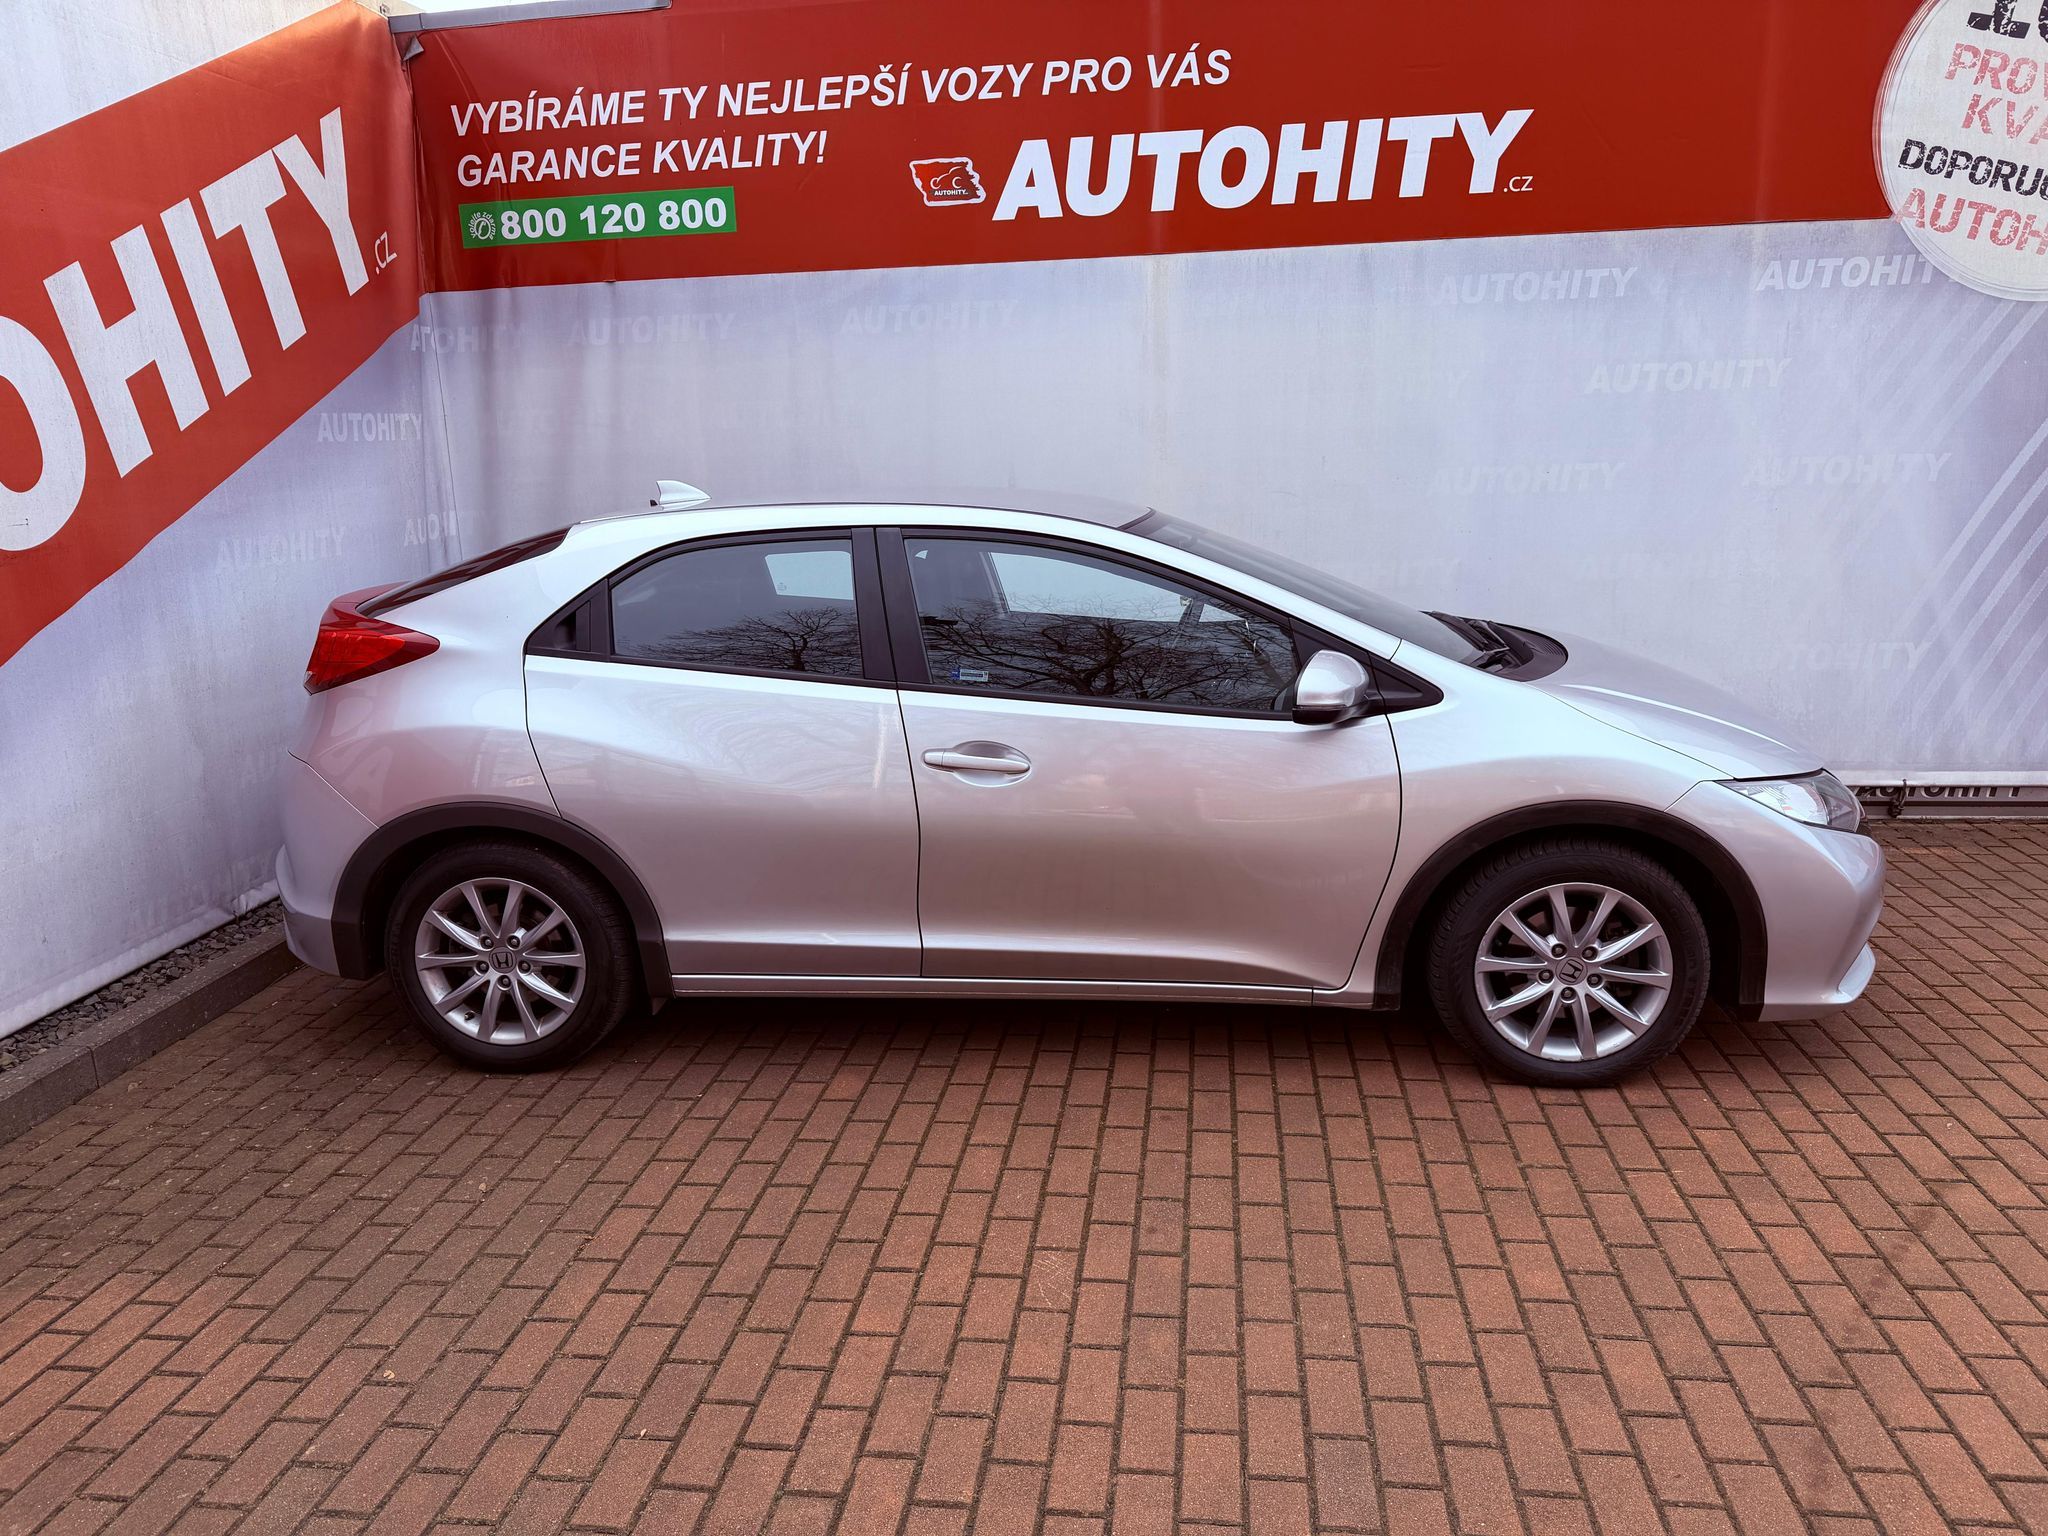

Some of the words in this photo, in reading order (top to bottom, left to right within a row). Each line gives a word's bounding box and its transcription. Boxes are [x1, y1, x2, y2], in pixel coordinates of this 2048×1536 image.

[451, 86, 645, 137] VYBÍRÁME
[659, 85, 708, 121] TY
[717, 62, 913, 118] NEJLEPŠÍ
[921, 62, 1034, 103] VOZY
[1041, 56, 1133, 96] PRO
[1146, 42, 1233, 89] VÁS
[457, 142, 642, 187] GARANCE
[652, 130, 828, 174] KVALITY!
[500, 207, 567, 240] 800
[579, 202, 646, 235] 120
[658, 197, 727, 231] 800
[1432, 264, 1638, 307] AUTOHITY
[568, 312, 736, 348] AUTOHITY
[1584, 356, 1793, 397] AUTOHITY
[316, 410, 422, 444] AUTOHITY
[1427, 462, 1626, 499] AUTOHITY
[1742, 452, 1953, 488] AUTOHITY
[214, 526, 346, 575] AUTOHITY
